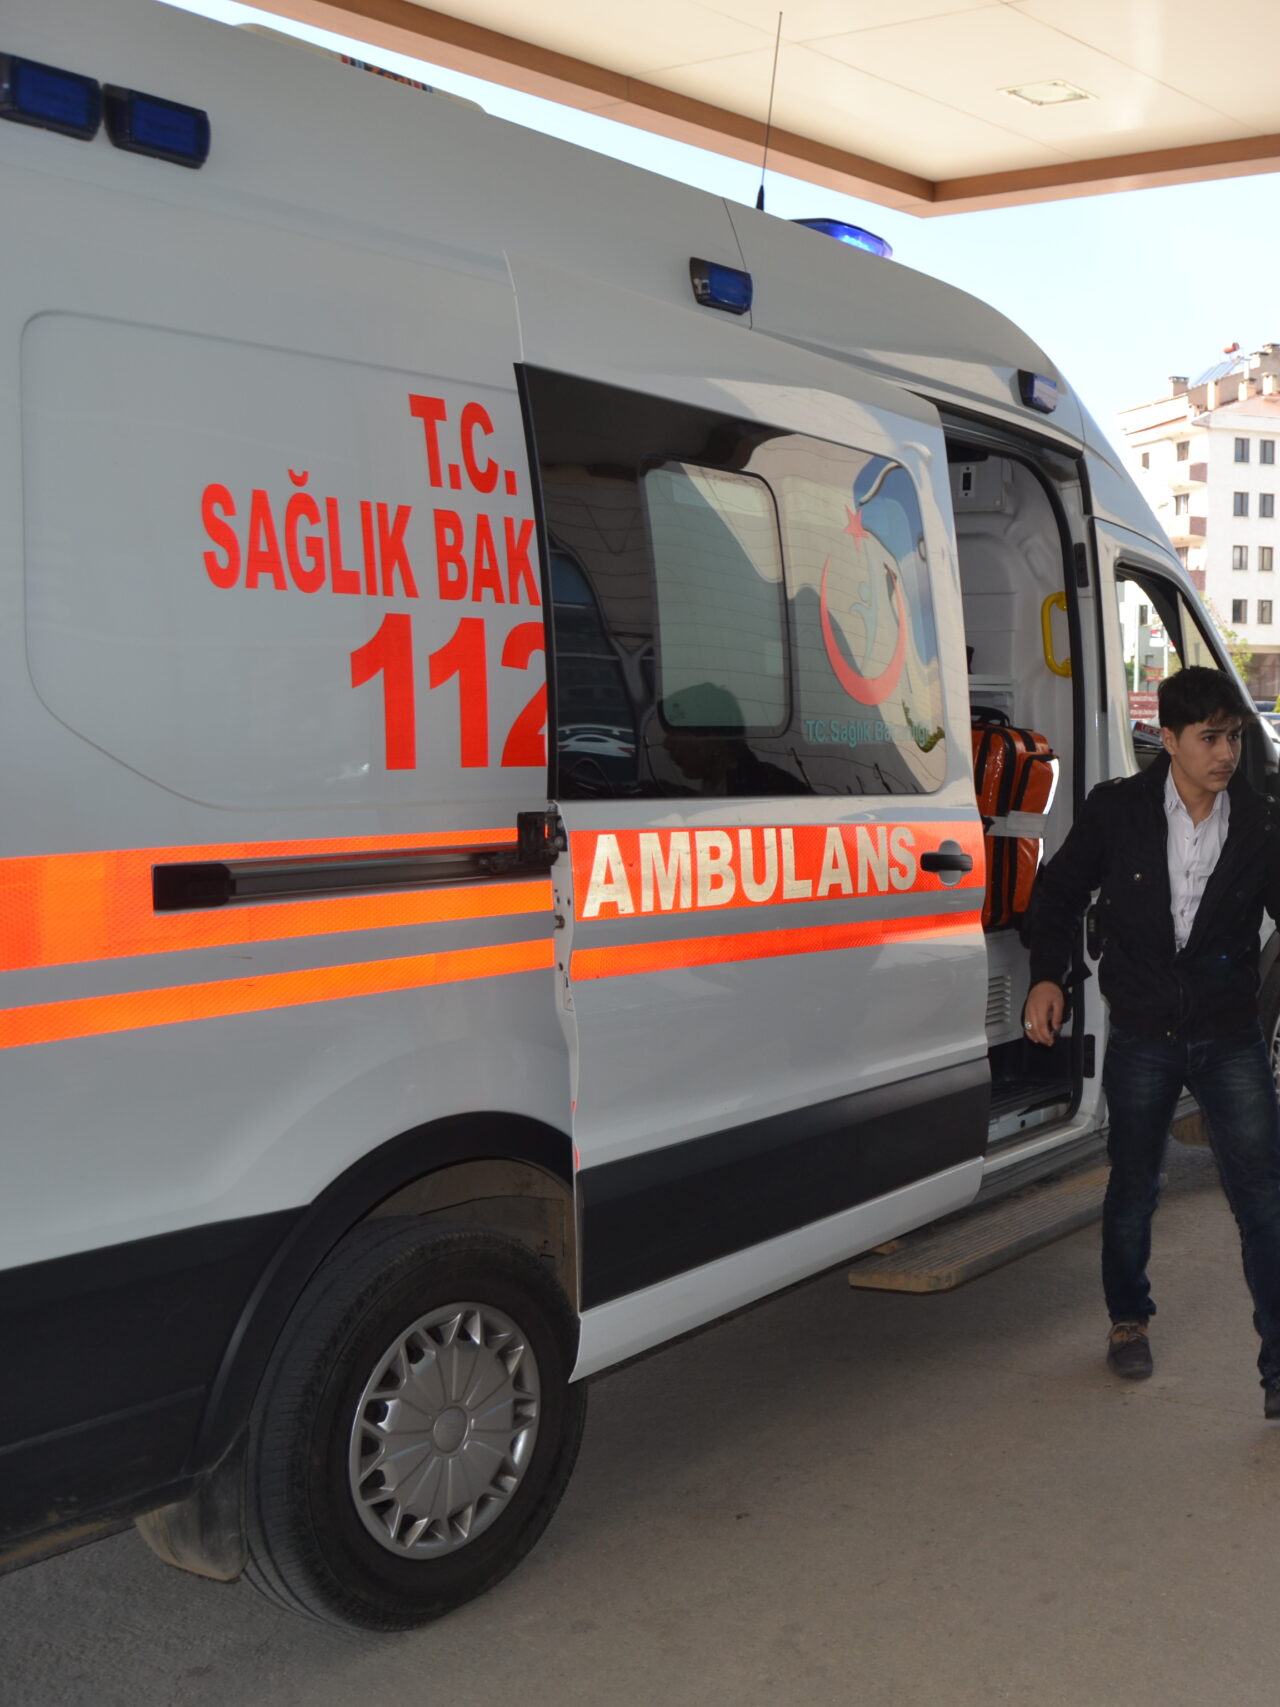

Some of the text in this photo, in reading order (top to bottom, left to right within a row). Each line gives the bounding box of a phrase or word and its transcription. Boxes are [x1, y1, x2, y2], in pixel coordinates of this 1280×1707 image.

[408, 393, 518, 496] T.C.
[201, 468, 420, 599] SAĞLIK
[350, 612, 548, 771] 112
[582, 826, 917, 918] AMBULANS
